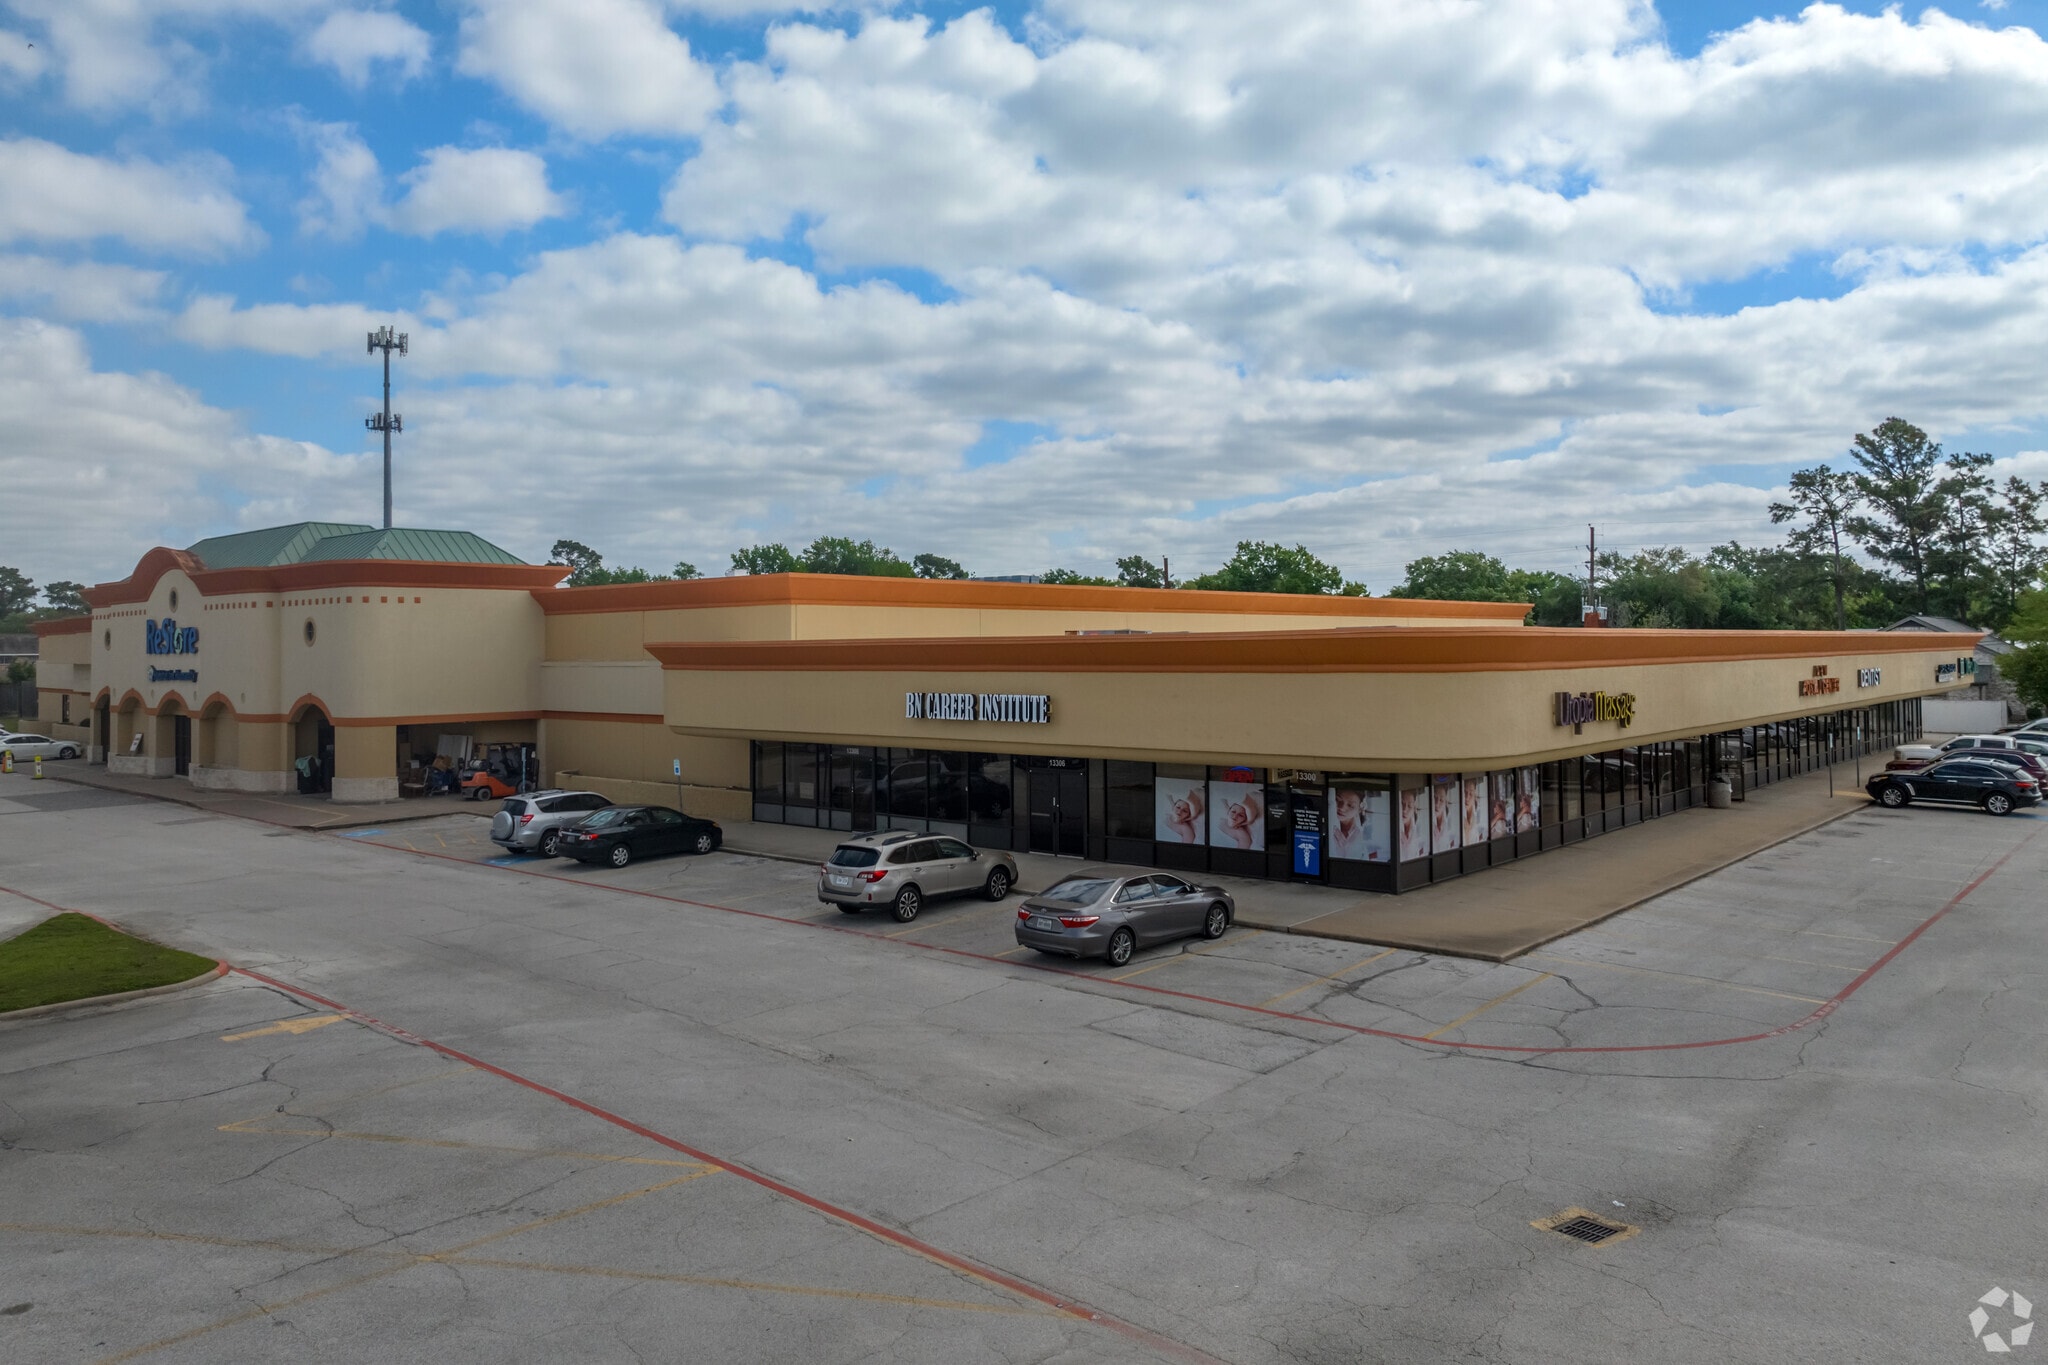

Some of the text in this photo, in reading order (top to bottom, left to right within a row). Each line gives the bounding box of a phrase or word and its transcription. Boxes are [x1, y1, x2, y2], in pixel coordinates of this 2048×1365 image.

[146, 618, 199, 655] ReStore
[1858, 667, 1881, 688] DENTIST
[905, 692, 1050, 723] BN CAREER INSTITUTE
[1049, 759, 1066, 768] 13306
[1295, 771, 1316, 782] 13300
